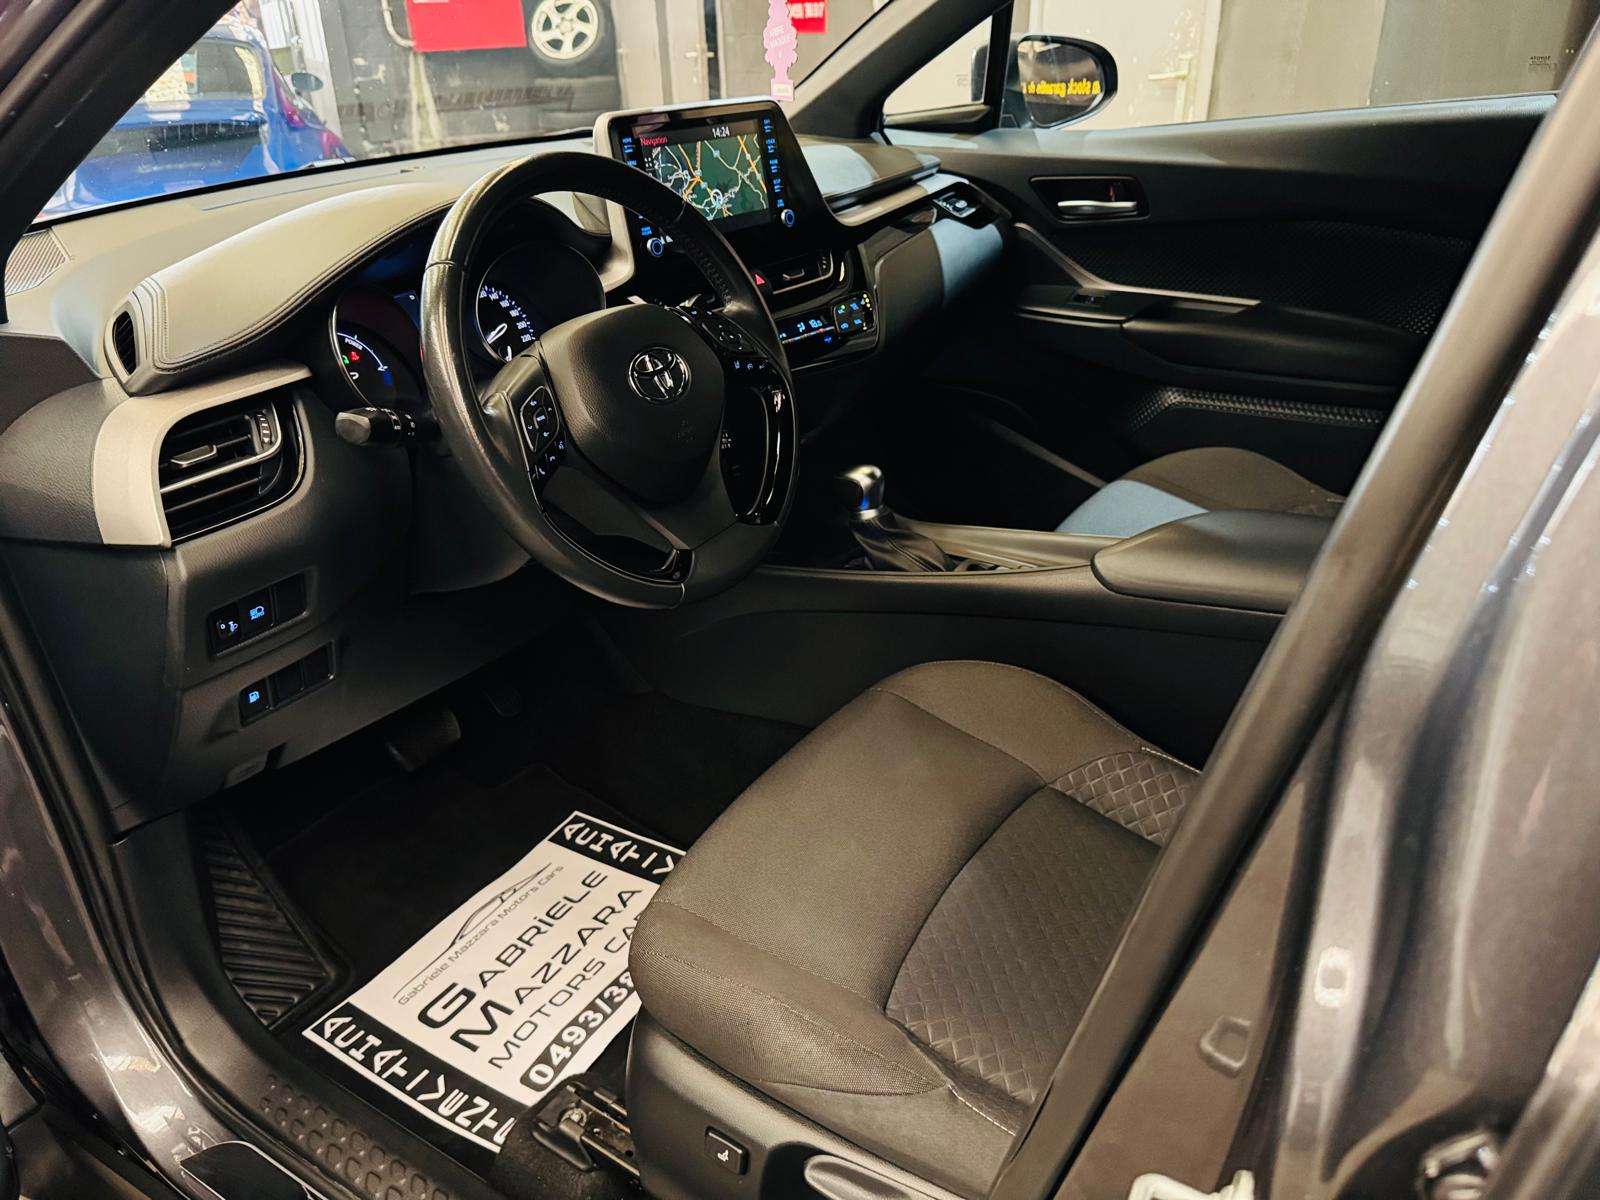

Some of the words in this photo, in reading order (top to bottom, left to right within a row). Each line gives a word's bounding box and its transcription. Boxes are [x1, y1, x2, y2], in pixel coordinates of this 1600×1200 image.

[640, 135, 668, 147] Navigation
[711, 126, 730, 138] 14:24
[497, 886, 540, 920] Motors
[449, 888, 644, 1053] MAZZARA
[487, 957, 606, 1069] MOTORS
[603, 913, 643, 954] CA
